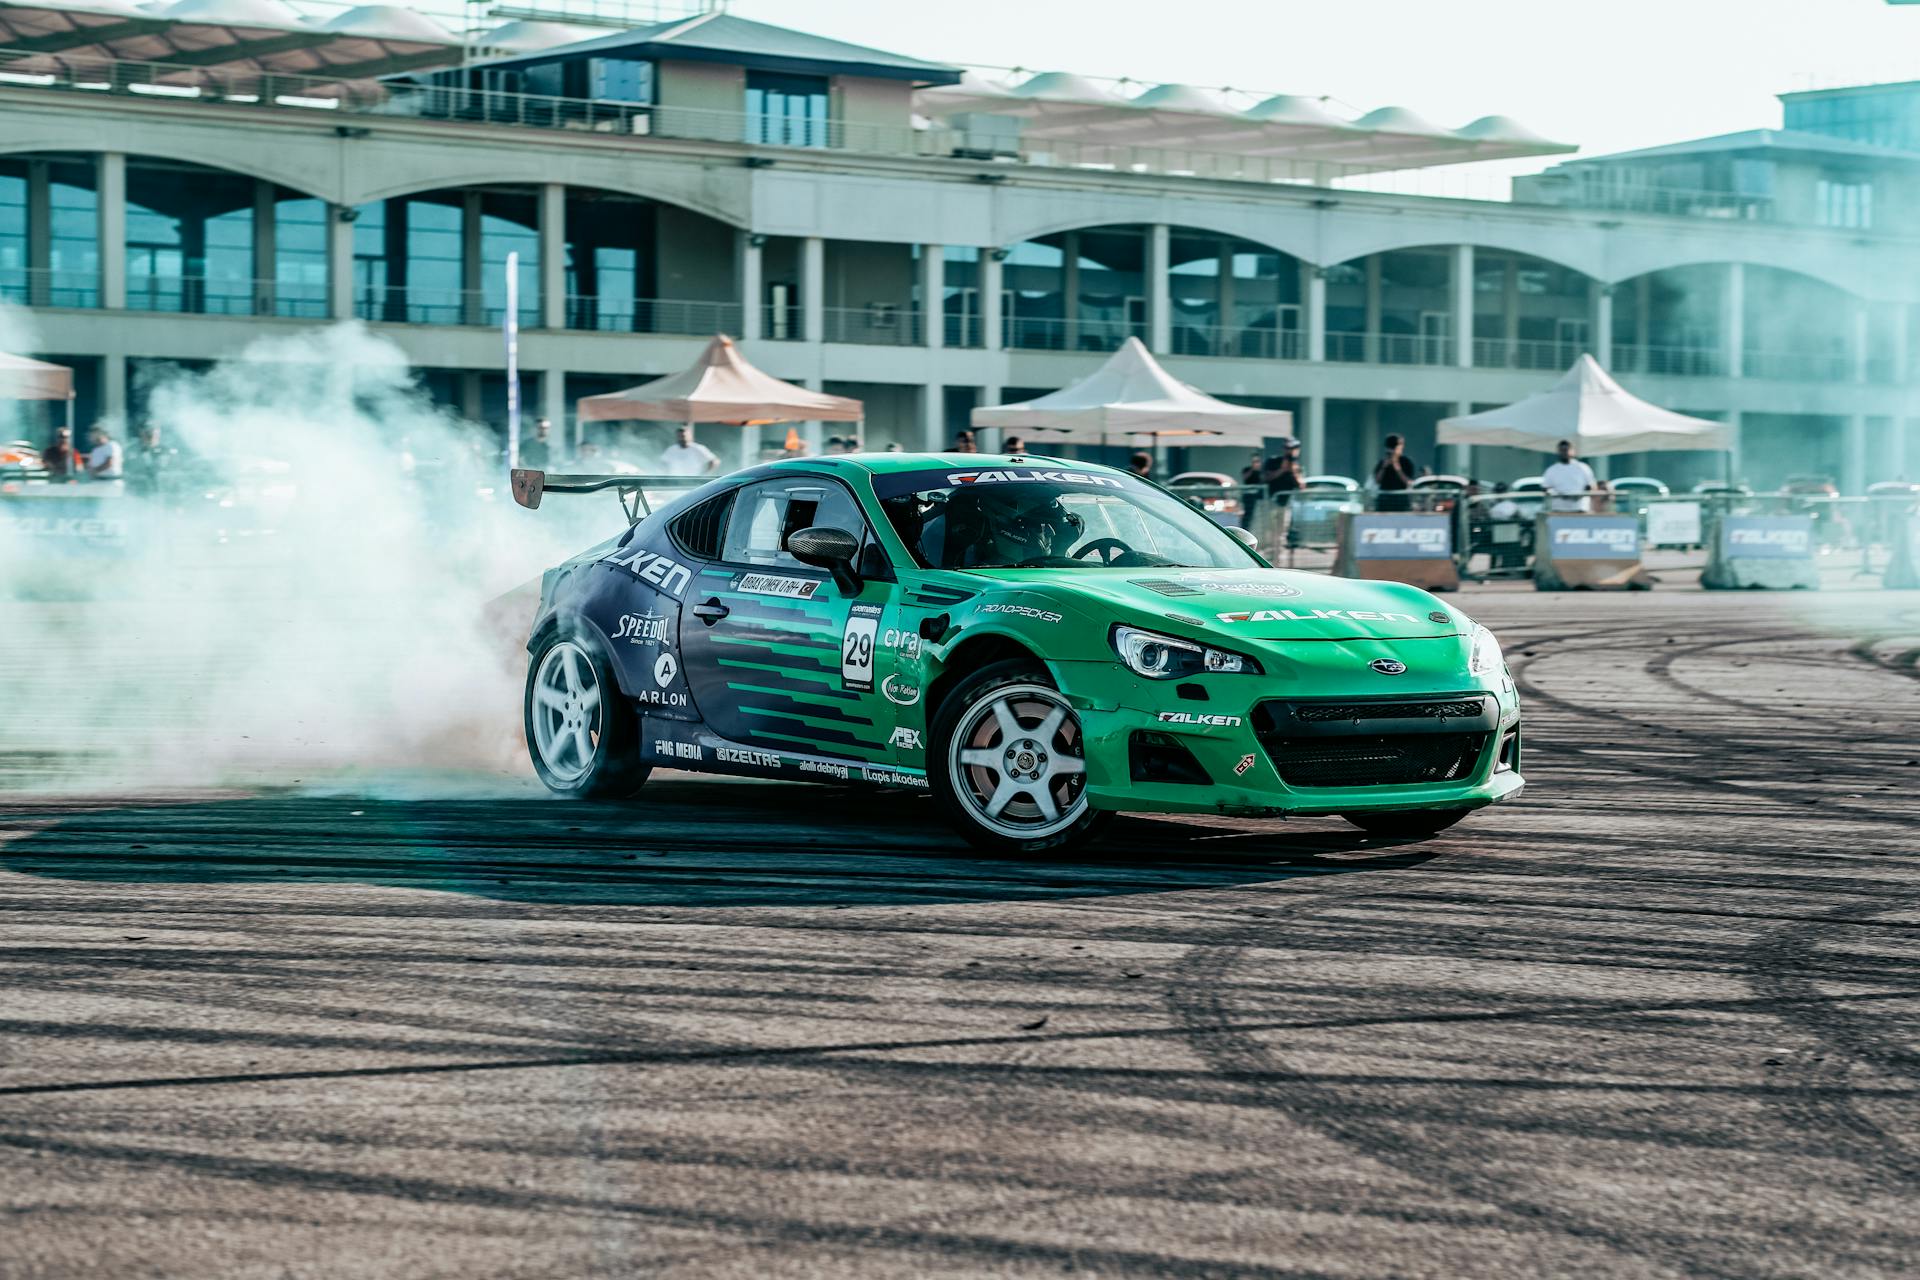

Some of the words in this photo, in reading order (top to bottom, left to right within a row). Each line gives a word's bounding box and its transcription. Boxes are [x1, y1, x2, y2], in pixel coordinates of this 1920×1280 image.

[947, 471, 1124, 489] FALKEN
[1001, 529, 1028, 543] FALKEN
[982, 604, 1062, 623] ROADPECKER
[1217, 609, 1419, 623] FALKEN
[611, 614, 670, 646] SPEEDOL
[845, 632, 871, 668] 29
[639, 690, 687, 707] ARLON
[1158, 711, 1242, 727] FALKEN
[676, 741, 704, 760] MEDIA
[891, 773, 930, 788] Akademi
